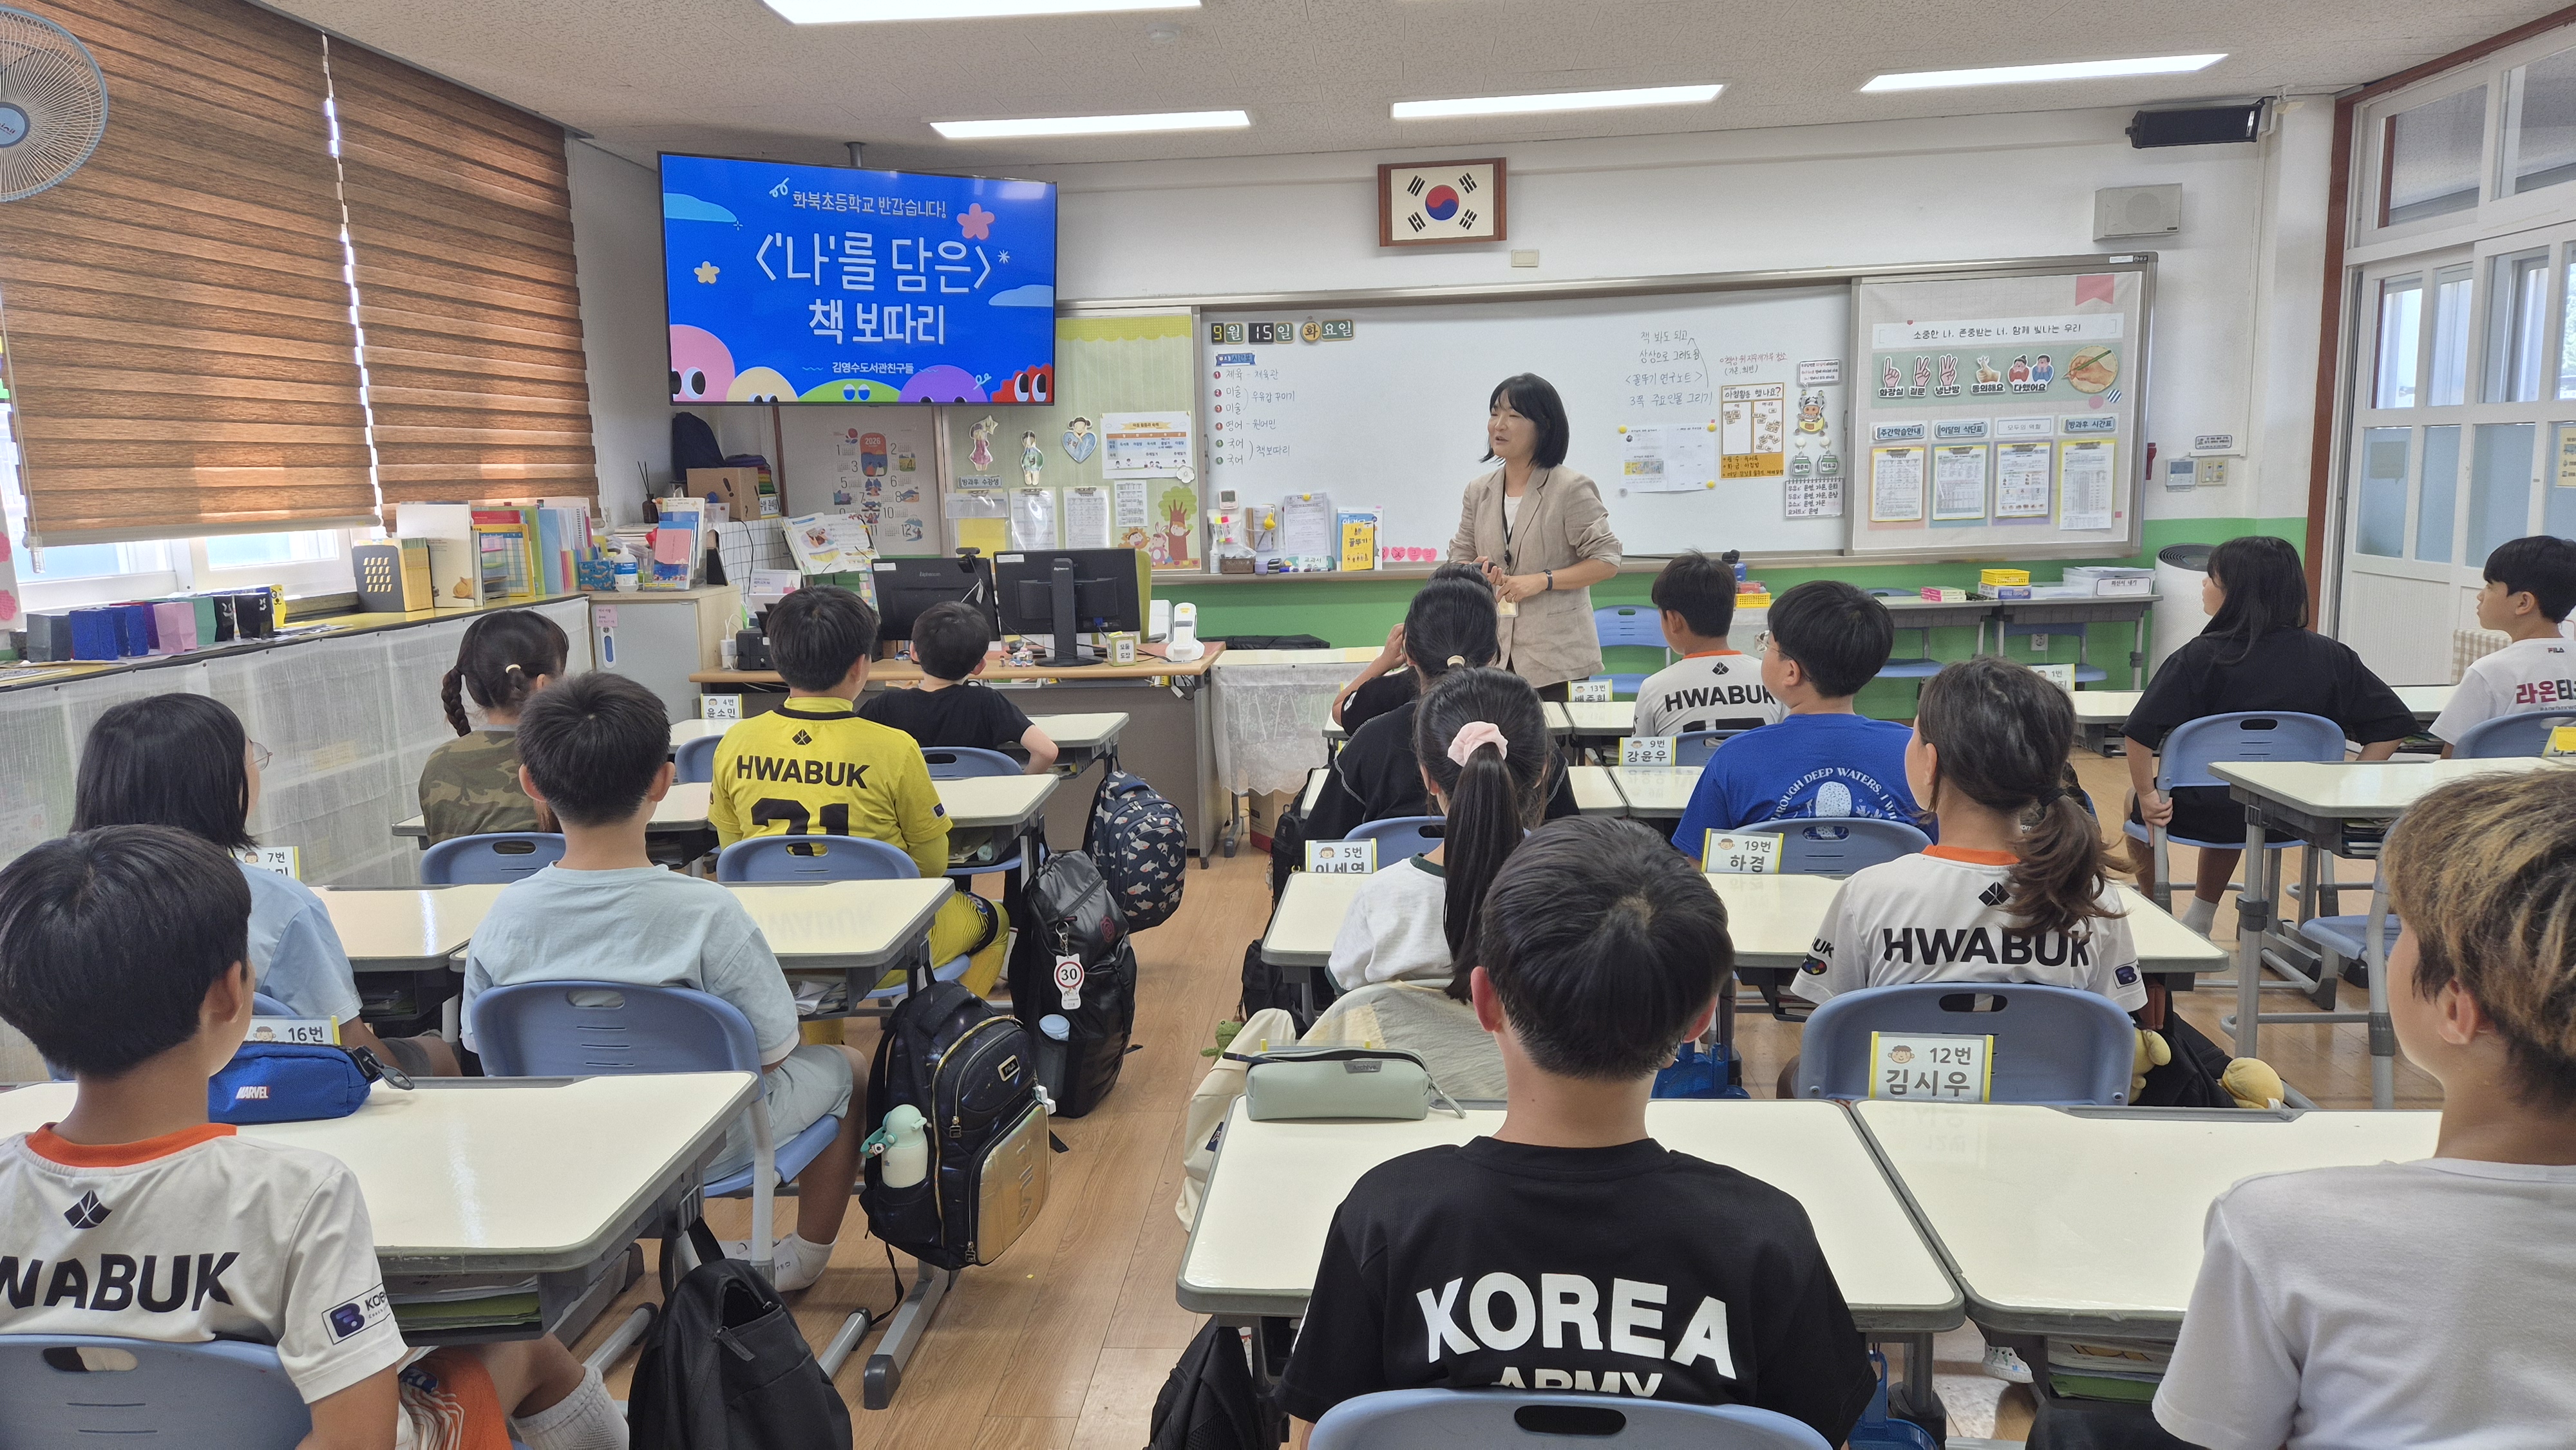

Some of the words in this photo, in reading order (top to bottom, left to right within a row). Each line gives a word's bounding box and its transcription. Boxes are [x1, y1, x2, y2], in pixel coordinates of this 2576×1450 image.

[793, 191, 874, 213] 화북초등학교
[878, 197, 946, 218] 반갑습니다!
[809, 299, 844, 344] 책
[857, 303, 945, 344] 보따리
[1655, 331, 1670, 343] 봐도
[1674, 330, 1687, 341] 되고
[1959, 328, 1992, 337] 존중받는
[2013, 326, 2029, 335] 함께
[2034, 324, 2060, 334] 빛나는
[2065, 324, 2081, 332] 우리
[1640, 348, 1669, 363] 상상으로
[832, 362, 914, 374] 김영수도서관친구들
[1226, 368, 1242, 381] 체육
[1255, 368, 1278, 380] 체육관
[1660, 372, 1691, 384] 연구노트
[1226, 386, 1241, 398] 미술
[1251, 392, 1272, 402] 우유갑
[1275, 391, 1295, 402] 꾸미기
[1935, 386, 1960, 395] 냉난방
[1972, 384, 2004, 393] 동의해요
[1630, 395, 1644, 407] 3쪽
[1652, 393, 1683, 406] 주요인물
[1687, 391, 1712, 405] 그리기
[1226, 403, 1241, 415] 미술
[1226, 421, 1243, 431] 영어
[1252, 419, 1276, 430] 원어민
[1940, 426, 1959, 434] 이달의
[1964, 425, 1983, 433] 식단표
[2069, 420, 2088, 429] 방과후
[2092, 419, 2112, 428] 시간표
[1880, 427, 1921, 437] 주간학습안내
[891, 443, 896, 455] 2
[1067, 438, 1078, 449] 우리
[1227, 438, 1244, 449] 국어
[1256, 445, 1290, 457] 책보따리
[851, 460, 858, 472] 3
[907, 459, 913, 470] 4
[1227, 455, 1243, 465] 국어
[840, 477, 848, 488] 5
[891, 475, 896, 487] 6
[859, 492, 864, 504] 7
[895, 491, 902, 502] 8
[884, 507, 893, 518] 10
[870, 525, 878, 536] 11
[902, 524, 912, 536] 12
[1665, 685, 1778, 713] HWABUK
[706, 708, 735, 718] 윤소민
[1627, 751, 1667, 762] 강윤우
[737, 755, 871, 789] HWABUK
[1804, 767, 1833, 784] DEEP
[1344, 847, 1362, 858] 5번
[1744, 840, 1772, 853] 19번
[267, 852, 285, 863] 7번
[1730, 855, 1765, 872] 하겸
[1812, 936, 1834, 959] UK
[1883, 927, 2094, 967] HWABUK
[1061, 968, 1077, 981] 30
[288, 1026, 323, 1043] 16번
[1929, 1046, 1972, 1066] 12번
[1005, 1062, 1016, 1074] FILA
[1885, 1069, 1971, 1097] 김시우
[236, 1086, 269, 1100] MARVEL
[1416, 1272, 1737, 1379] KOREA
